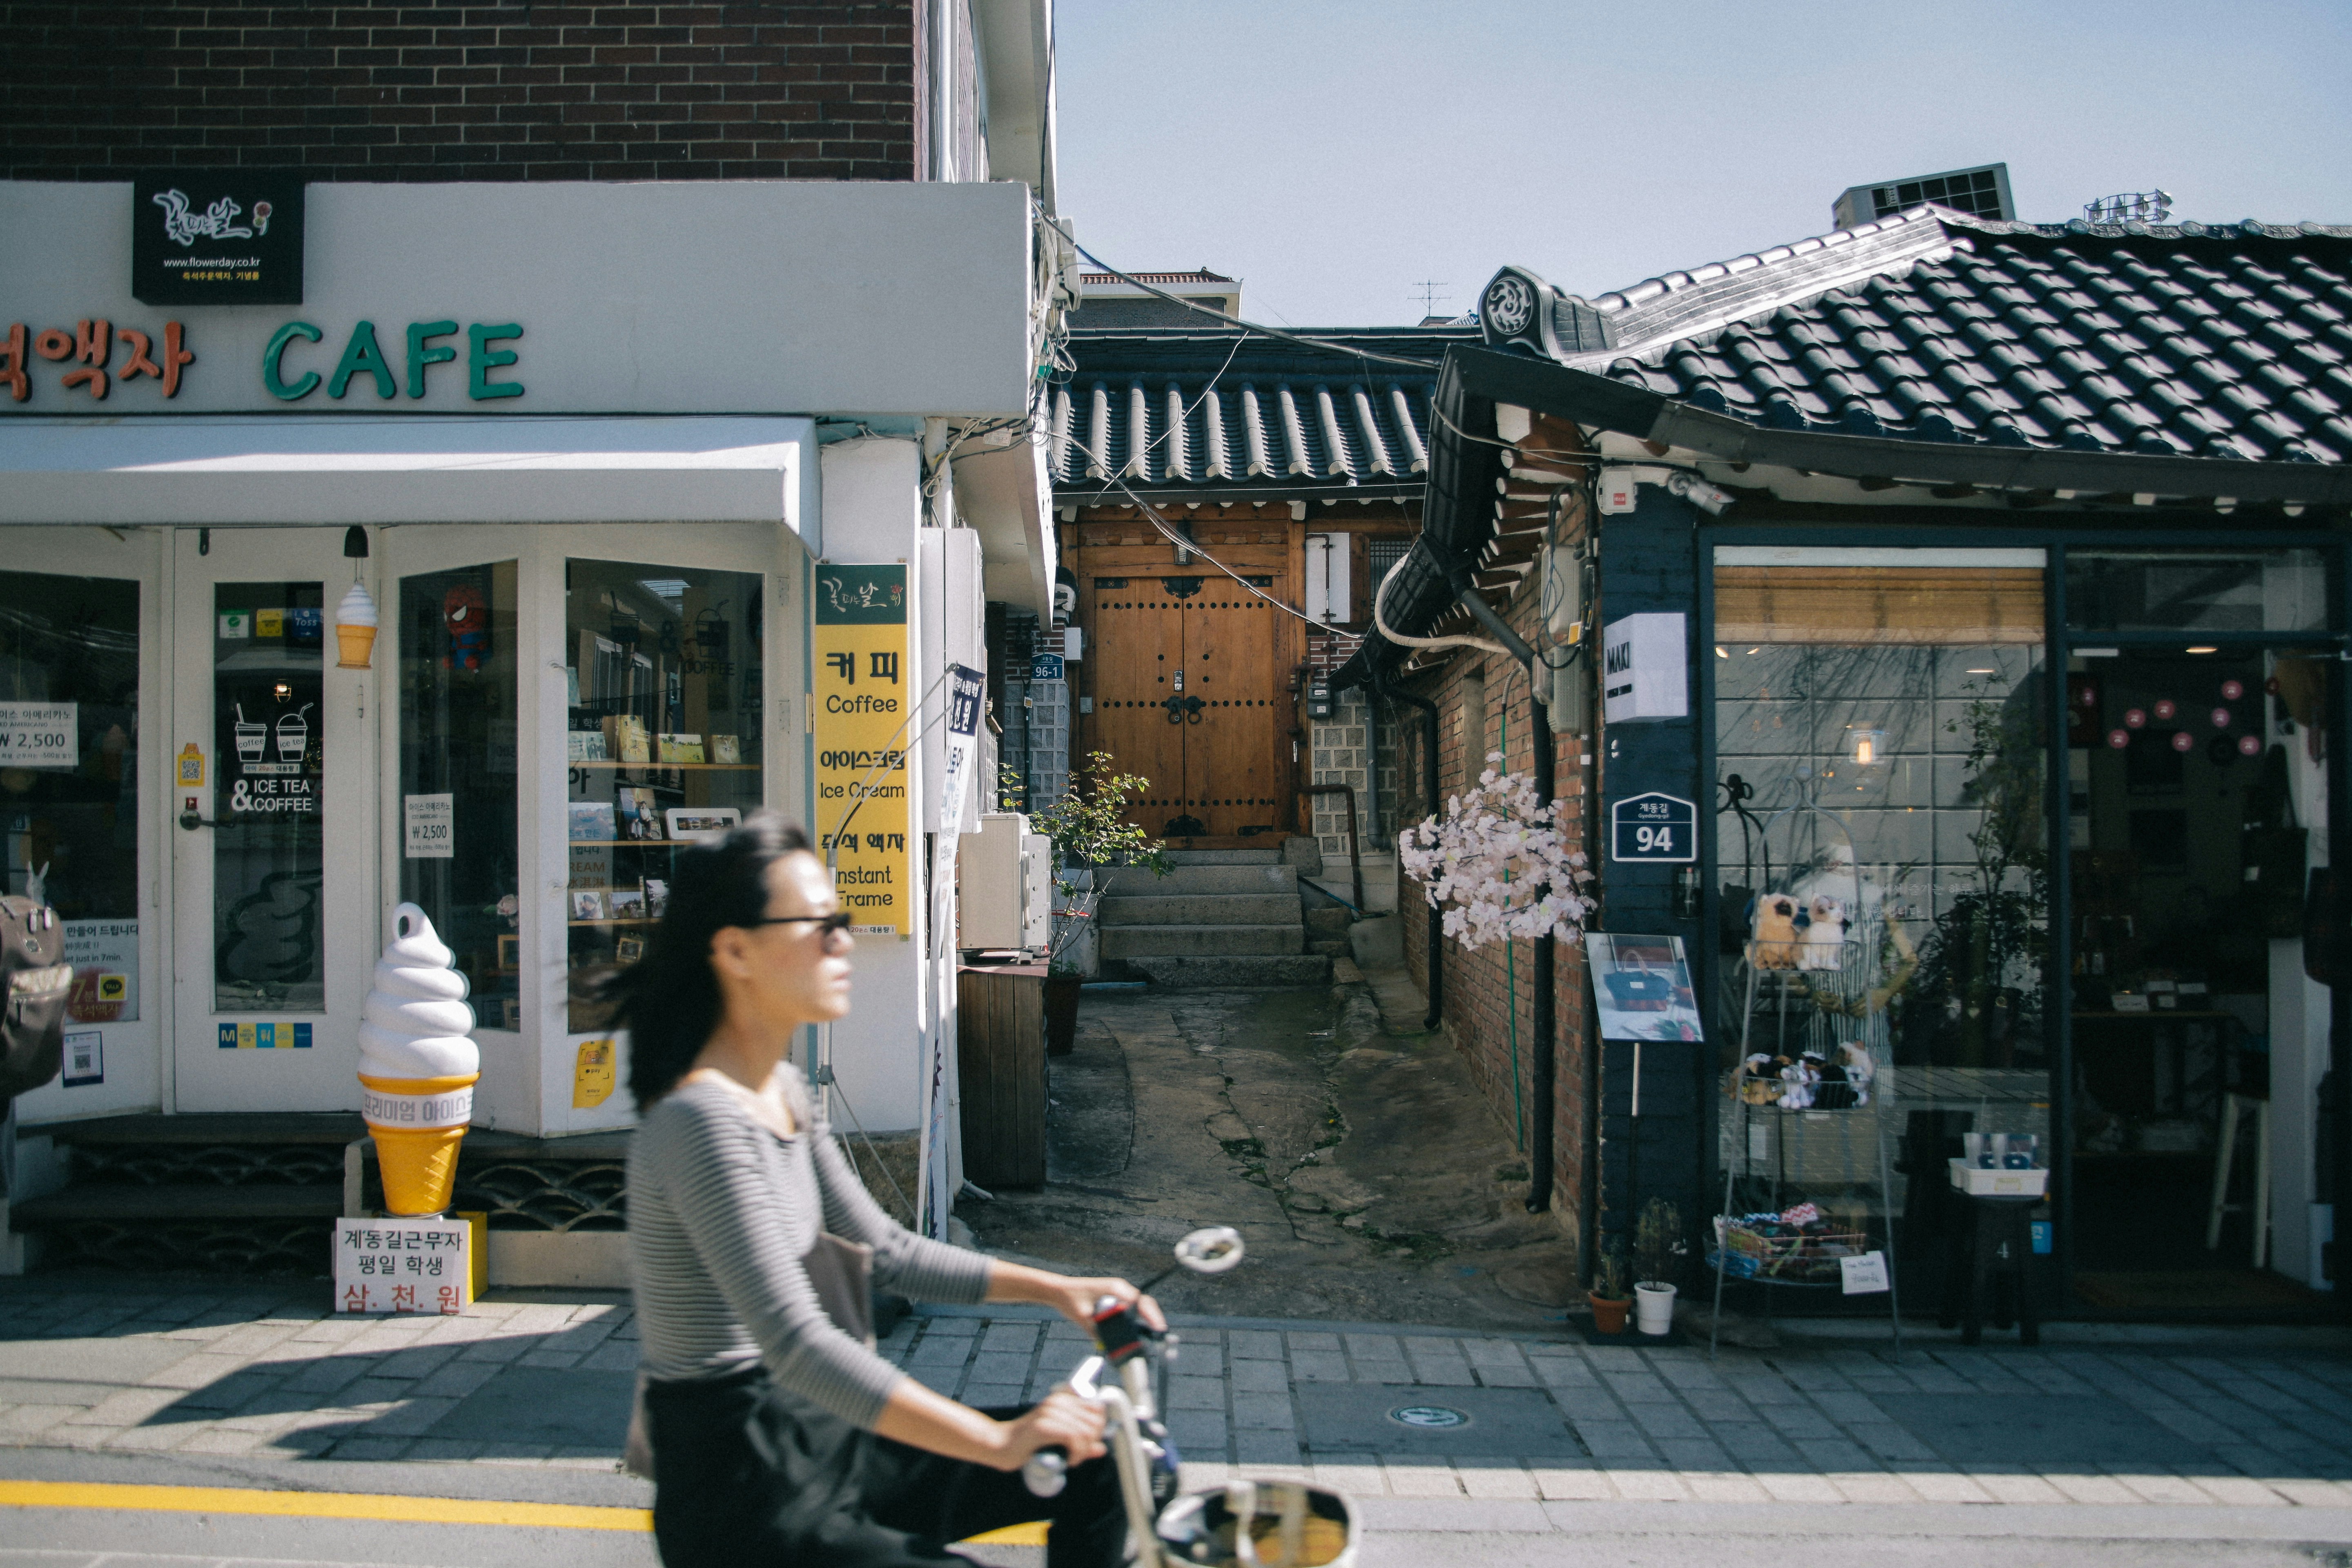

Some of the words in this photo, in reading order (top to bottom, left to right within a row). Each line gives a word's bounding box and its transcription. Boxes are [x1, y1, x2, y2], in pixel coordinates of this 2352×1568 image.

[164, 256, 261, 270] www.flowerday.co.kr
[263, 321, 524, 401] CAFE
[1606, 641, 1630, 675] MAKI
[1036, 666, 1057, 677] 96-1
[826, 694, 898, 714] Coffee
[23, 710, 72, 719] 아메리카노
[18, 733, 65, 749] 2,500
[238, 738, 265, 748] coffee
[820, 751, 905, 771] 아이스크림
[232, 779, 254, 811] &
[254, 780, 278, 793] ICE
[282, 780, 310, 793] TEA
[820, 782, 844, 798] Ice
[849, 781, 905, 798] Cream
[254, 798, 312, 811] COFFEE
[425, 802, 450, 811] 아메리카노
[1639, 803, 1668, 813] 계동길
[423, 825, 447, 841] 2,500
[1636, 826, 1673, 851] 94
[866, 833, 905, 853] 액자
[67, 926, 96, 937] 만들어
[100, 924, 138, 935] 드립니다
[76, 954, 89, 964] just
[221, 1029, 236, 1042] M
[359, 1255, 396, 1275] 평일
[406, 1255, 443, 1275] 학생
[437, 1285, 460, 1314] 원
